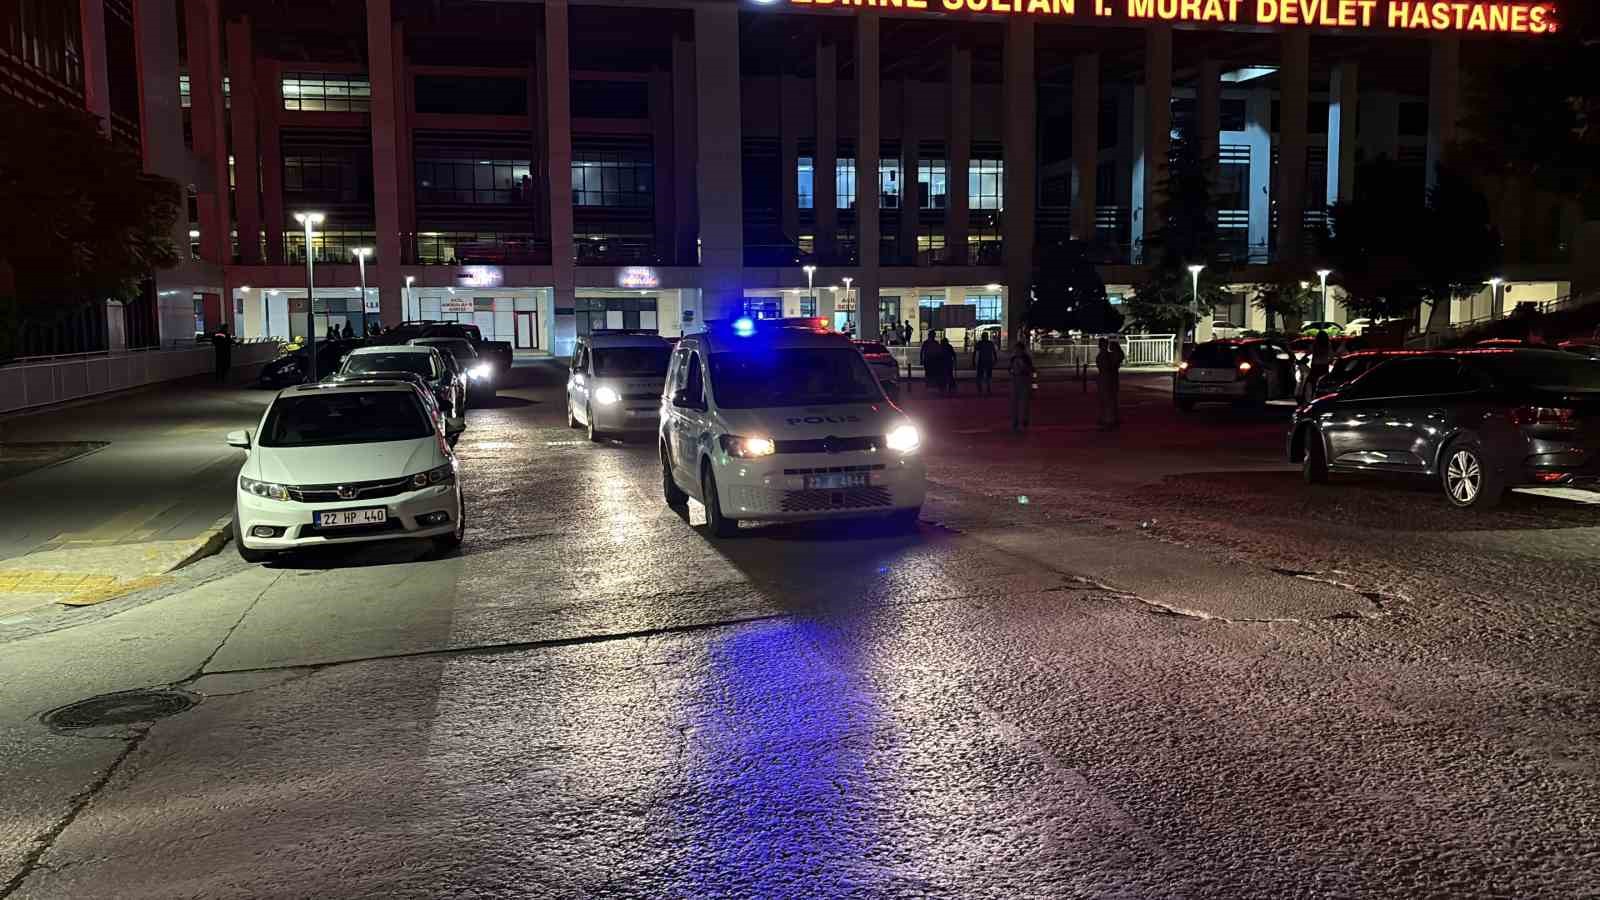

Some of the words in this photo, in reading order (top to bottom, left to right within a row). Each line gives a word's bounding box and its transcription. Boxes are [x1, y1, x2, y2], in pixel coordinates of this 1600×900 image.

[1127, 0, 1242, 22] MURAT
[1256, 0, 1377, 27] DEVLET
[324, 514, 337, 525] 22
[343, 512, 357, 523] HP
[364, 510, 384, 522] 440
